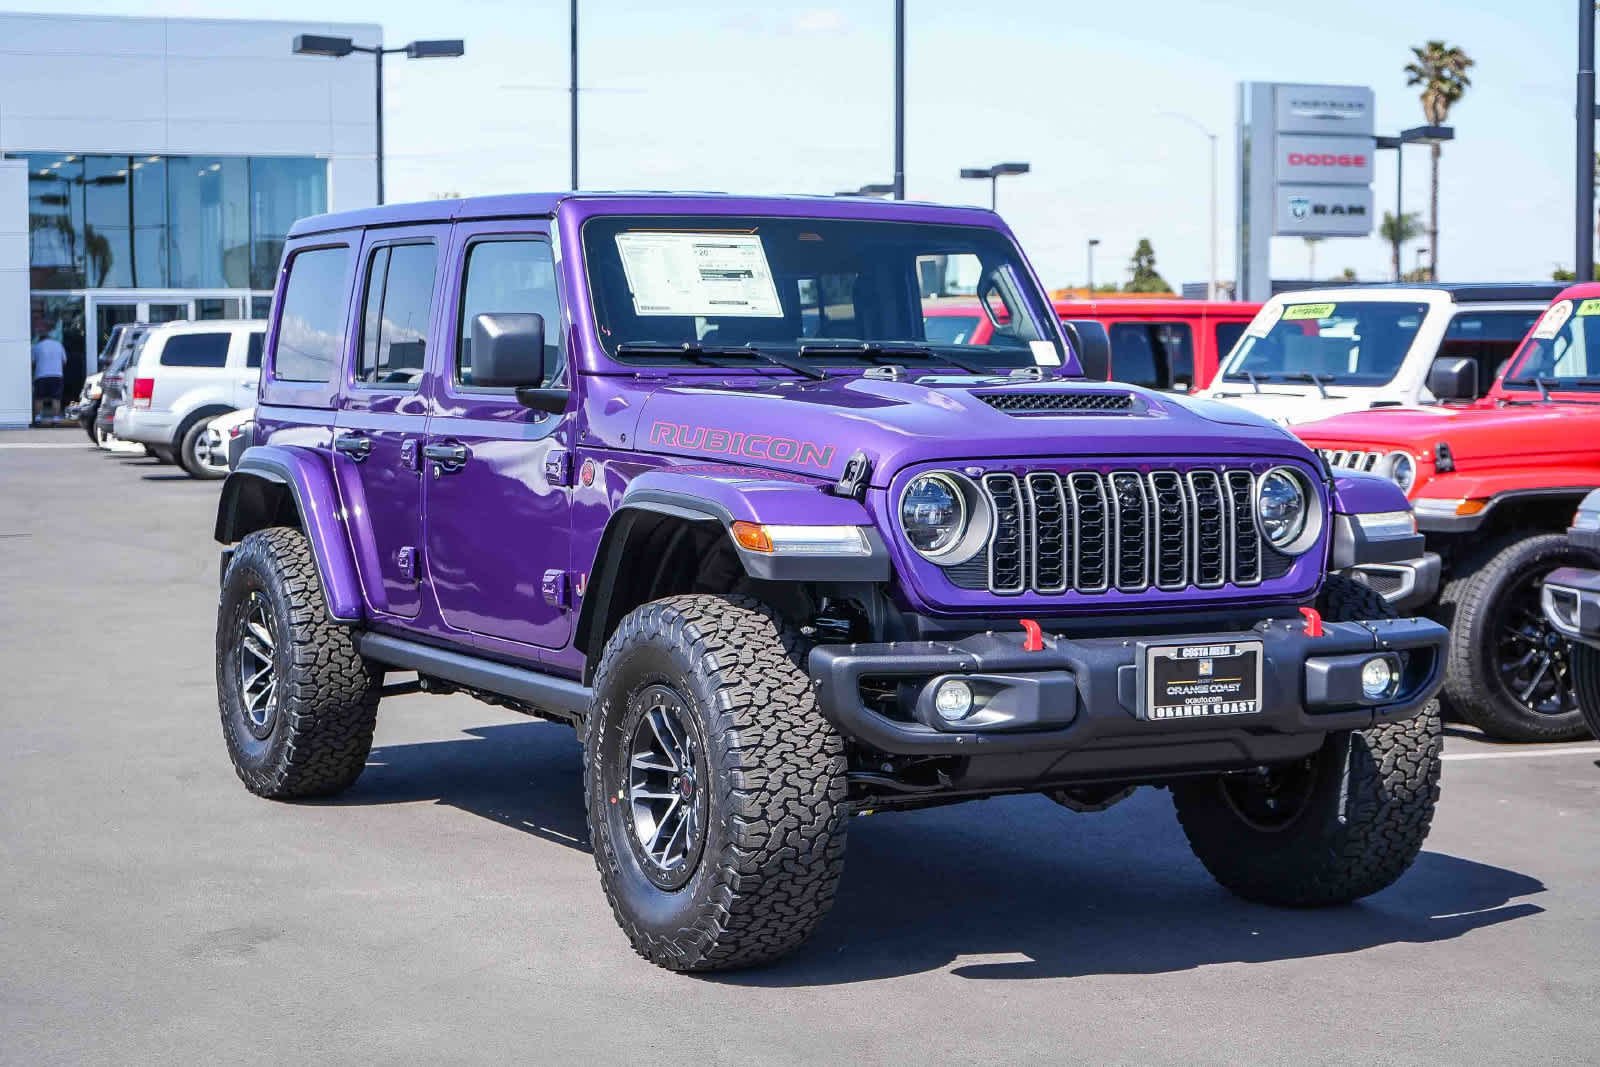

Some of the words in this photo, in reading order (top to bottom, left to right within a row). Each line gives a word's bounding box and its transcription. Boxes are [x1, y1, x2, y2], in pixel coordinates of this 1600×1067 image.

[1288, 152, 1366, 167] DODGE
[1313, 204, 1366, 215] RAM
[650, 421, 835, 469] RUBICON
[1182, 647, 1208, 657] COSTA
[1166, 684, 1209, 695] ORANGE
[1210, 683, 1241, 693] COAST
[1185, 696, 1222, 705] ocauto.com
[1156, 704, 1209, 718] ORANGE
[1213, 701, 1255, 714] COAST
